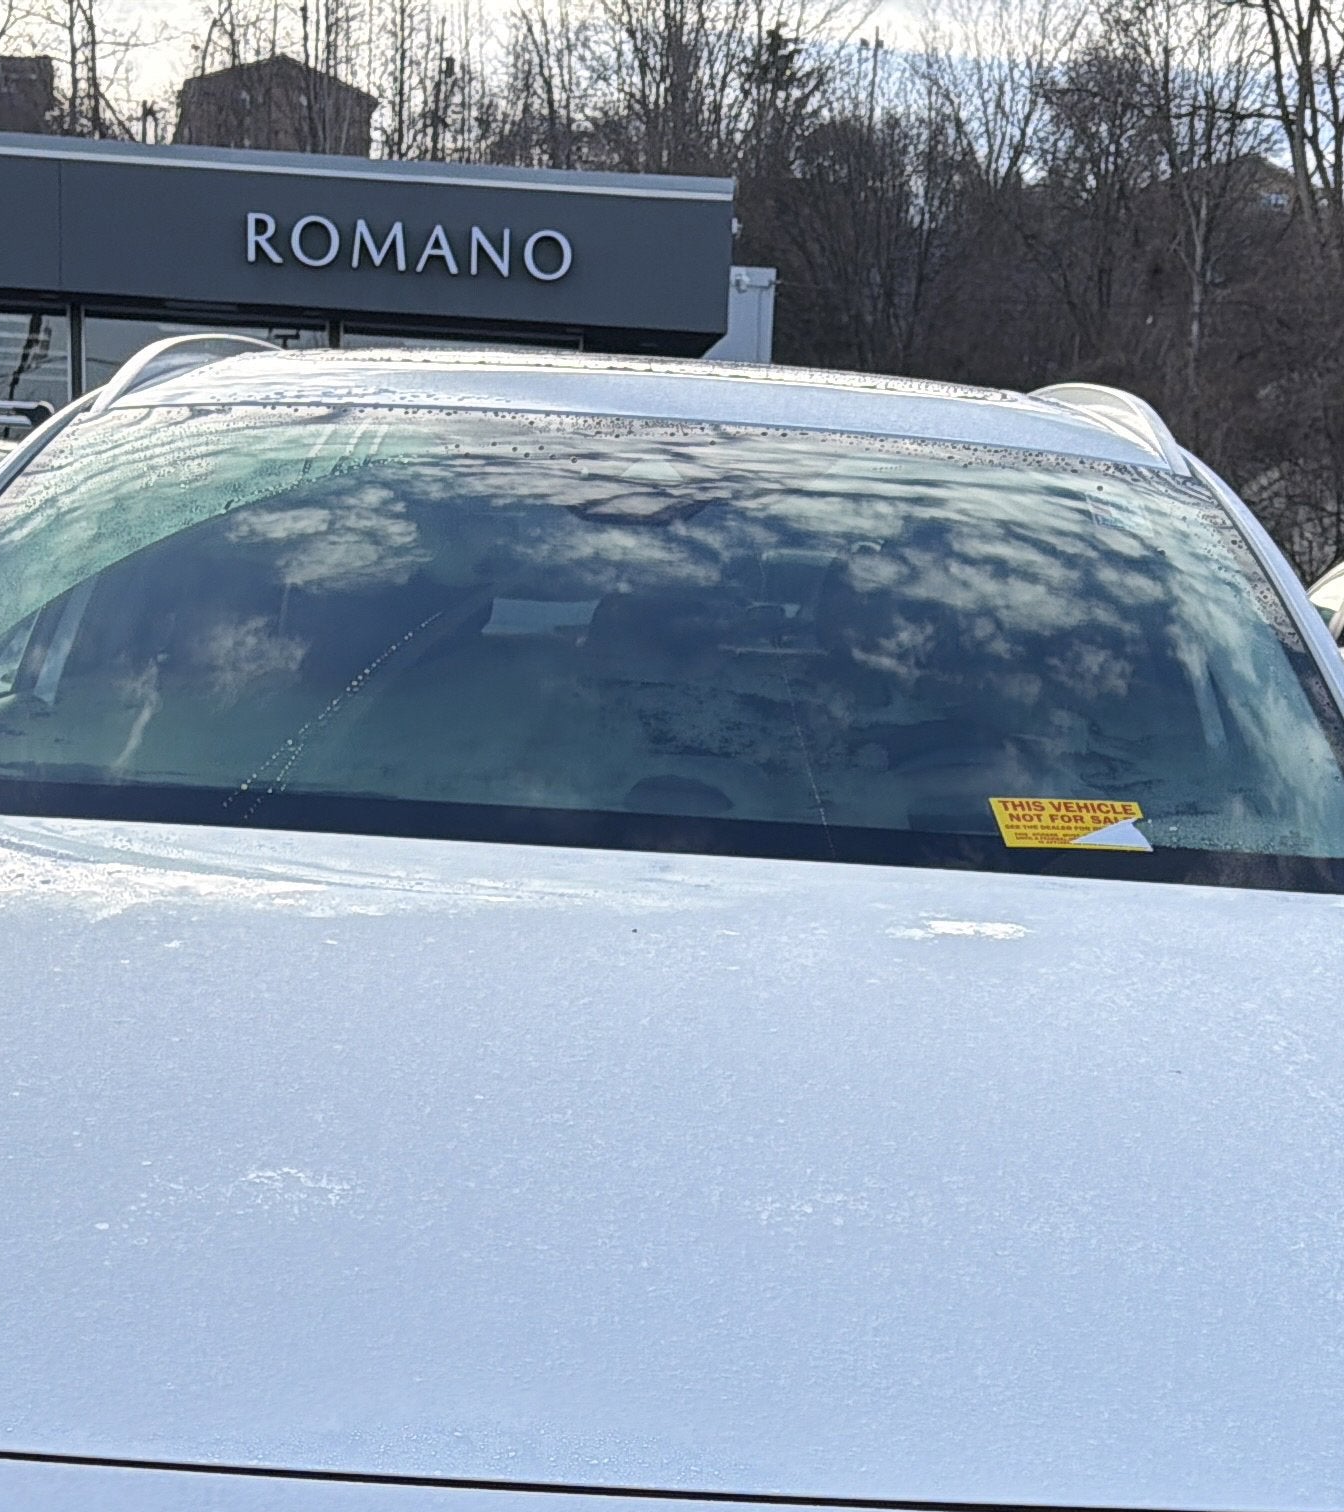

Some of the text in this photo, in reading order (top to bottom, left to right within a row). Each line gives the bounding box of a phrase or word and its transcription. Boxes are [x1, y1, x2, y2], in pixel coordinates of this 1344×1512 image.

[246, 212, 573, 282] ROMANO
[998, 800, 1136, 815] THIS VEHICLE
[1009, 813, 1133, 825] NOT FOR SAL
